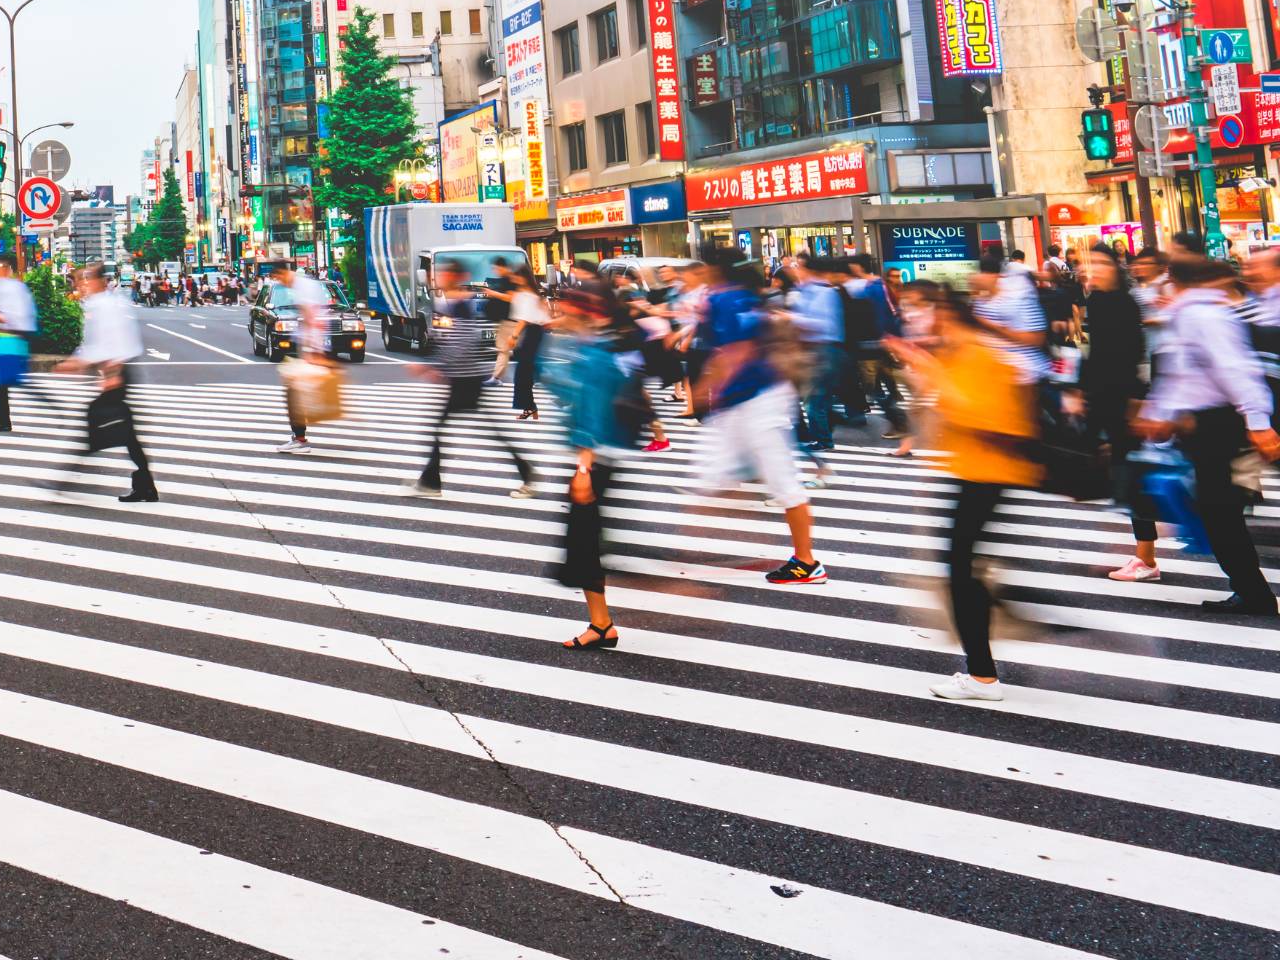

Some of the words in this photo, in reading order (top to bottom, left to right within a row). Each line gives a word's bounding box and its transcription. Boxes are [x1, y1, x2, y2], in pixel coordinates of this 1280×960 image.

[526, 102, 537, 137] GAME
[824, 152, 862, 173] 処方せん受付
[703, 160, 822, 201] クスリの龍生堂薬局
[644, 197, 669, 212] atmos
[561, 216, 575, 228] GAME
[607, 209, 624, 222] GAME
[892, 226, 966, 239] SUBNADE
